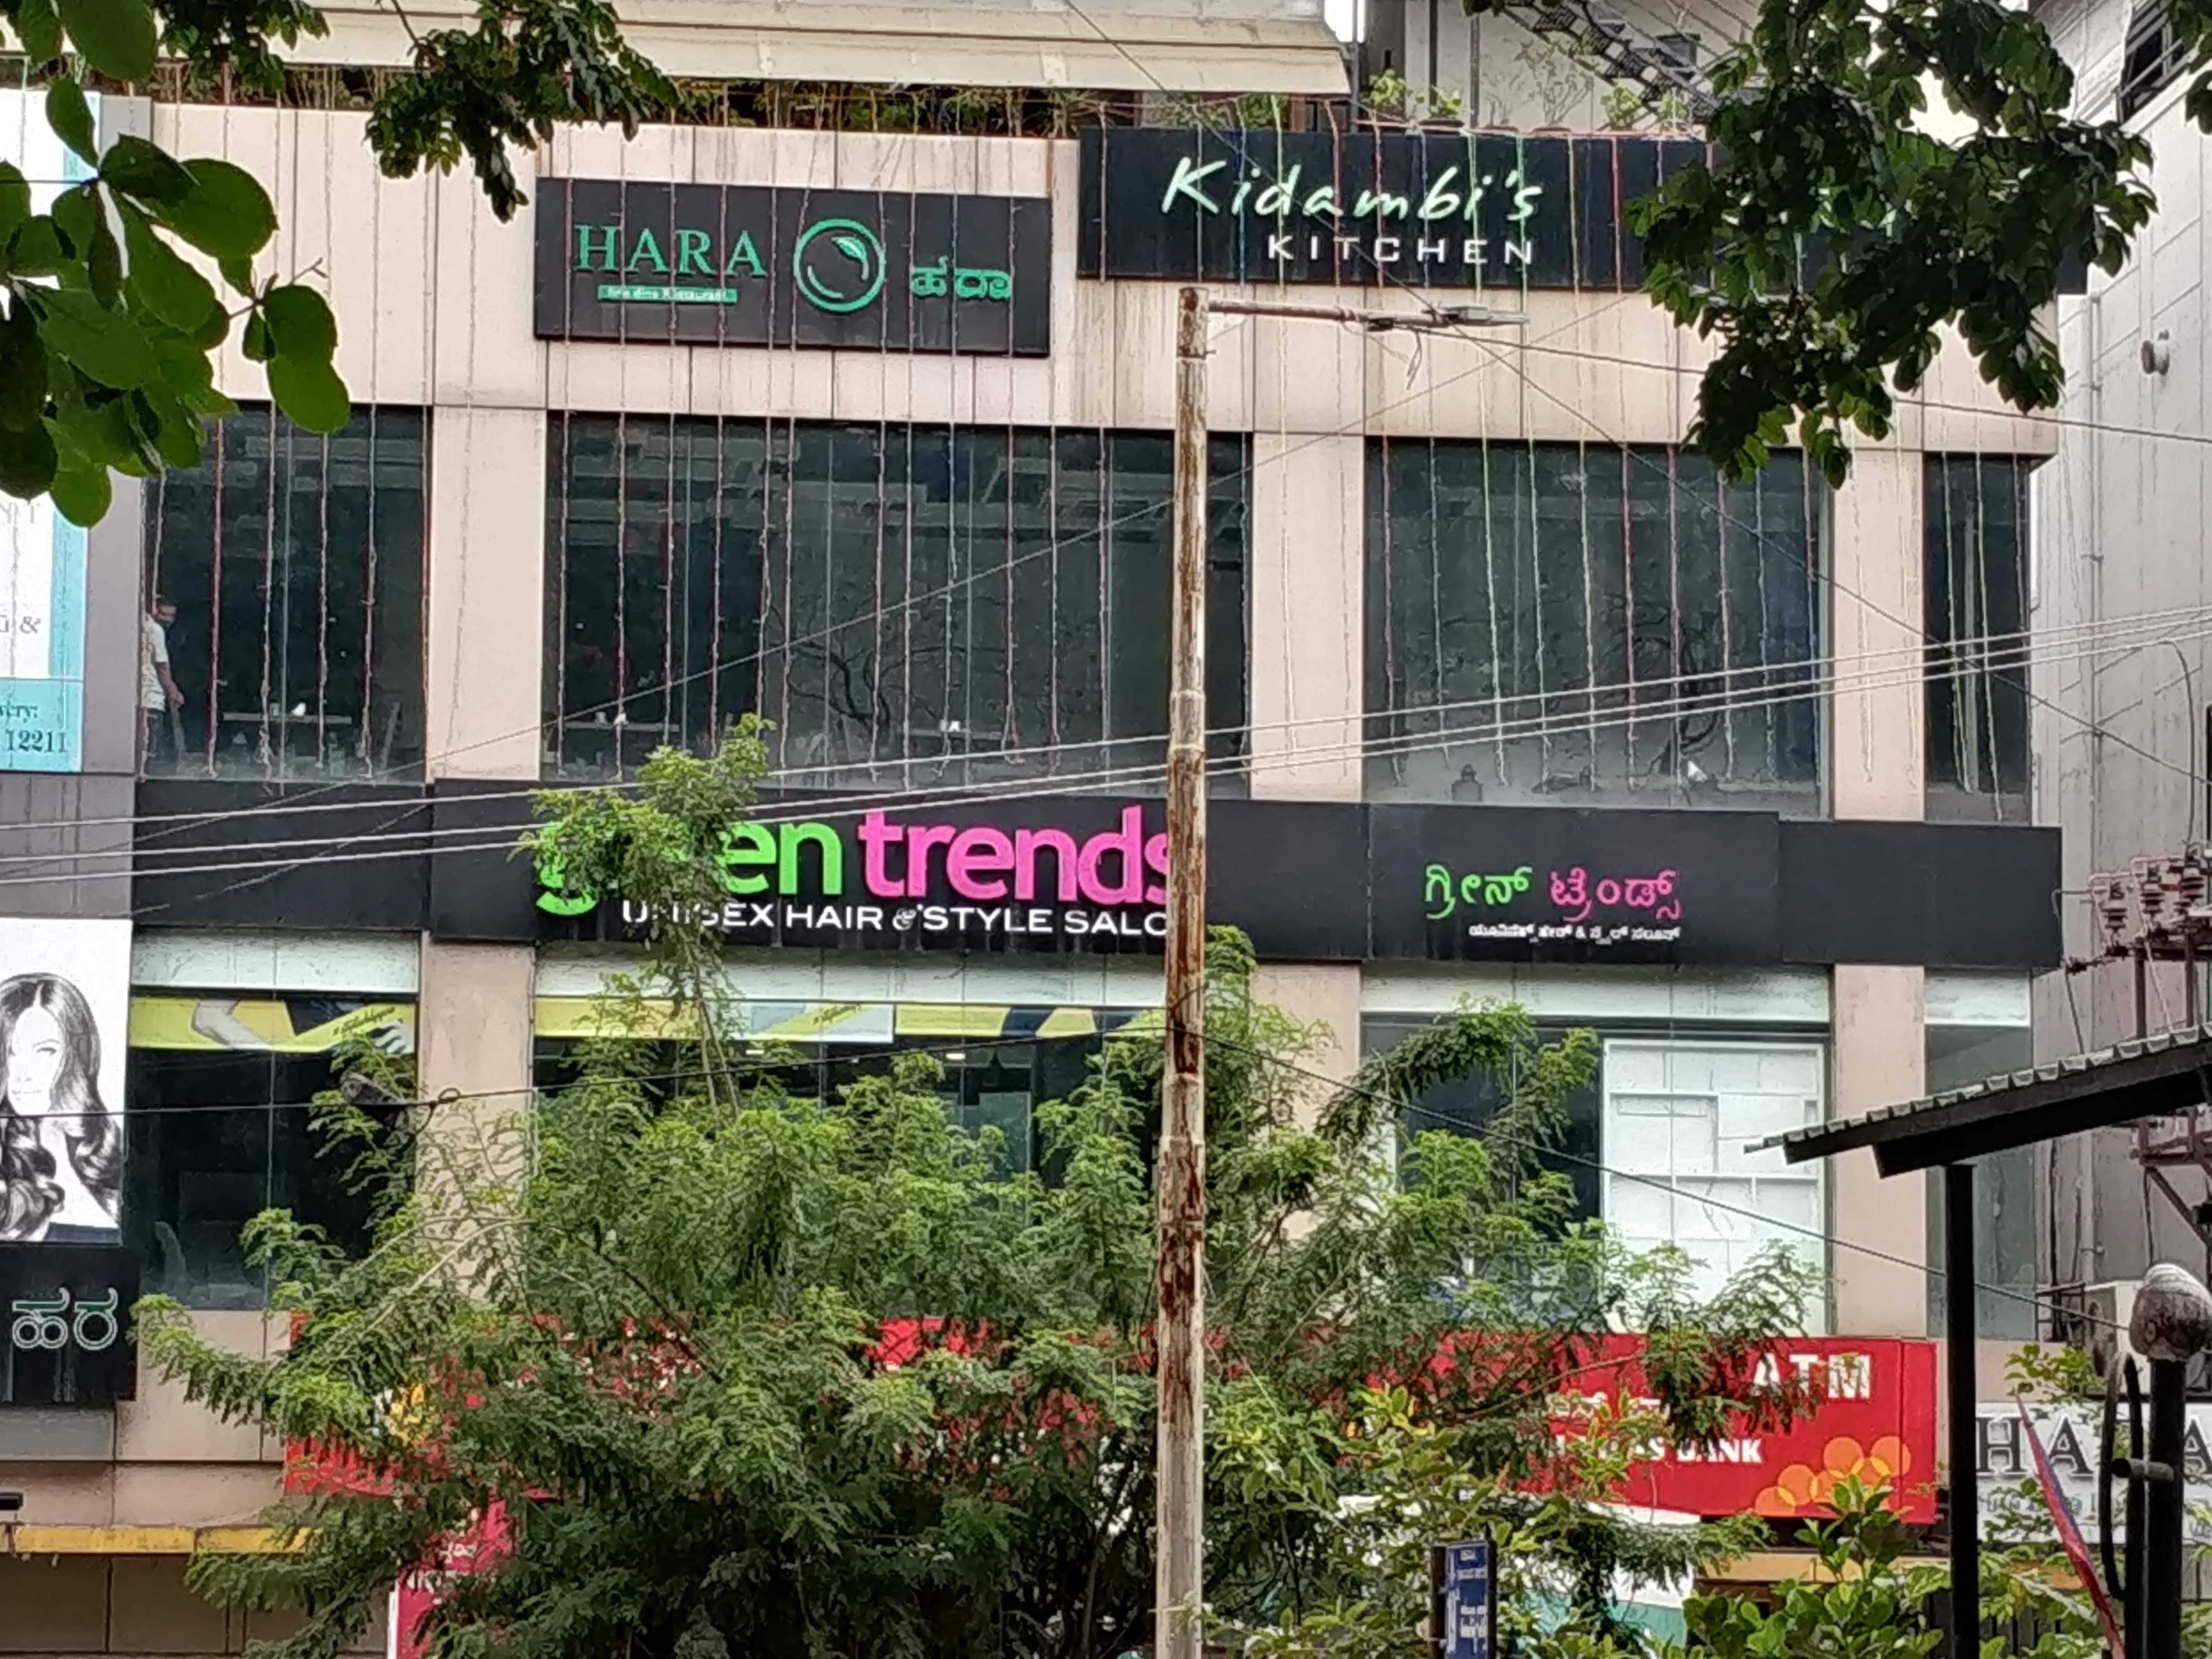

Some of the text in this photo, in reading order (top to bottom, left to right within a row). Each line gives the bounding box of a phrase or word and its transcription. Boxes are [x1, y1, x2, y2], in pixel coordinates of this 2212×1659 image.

[1162, 156, 1542, 220] Kidambi's
[574, 225, 768, 276] HARA
[1268, 234, 1531, 264] KITCHEN
[534, 819, 843, 916] gen
[786, 904, 882, 930] HAIR
[923, 906, 1053, 933] STYLE
[1064, 911, 1166, 936] SALO
[1751, 1352, 1871, 1399] ATM
[1976, 1416, 2212, 1475] HAA
